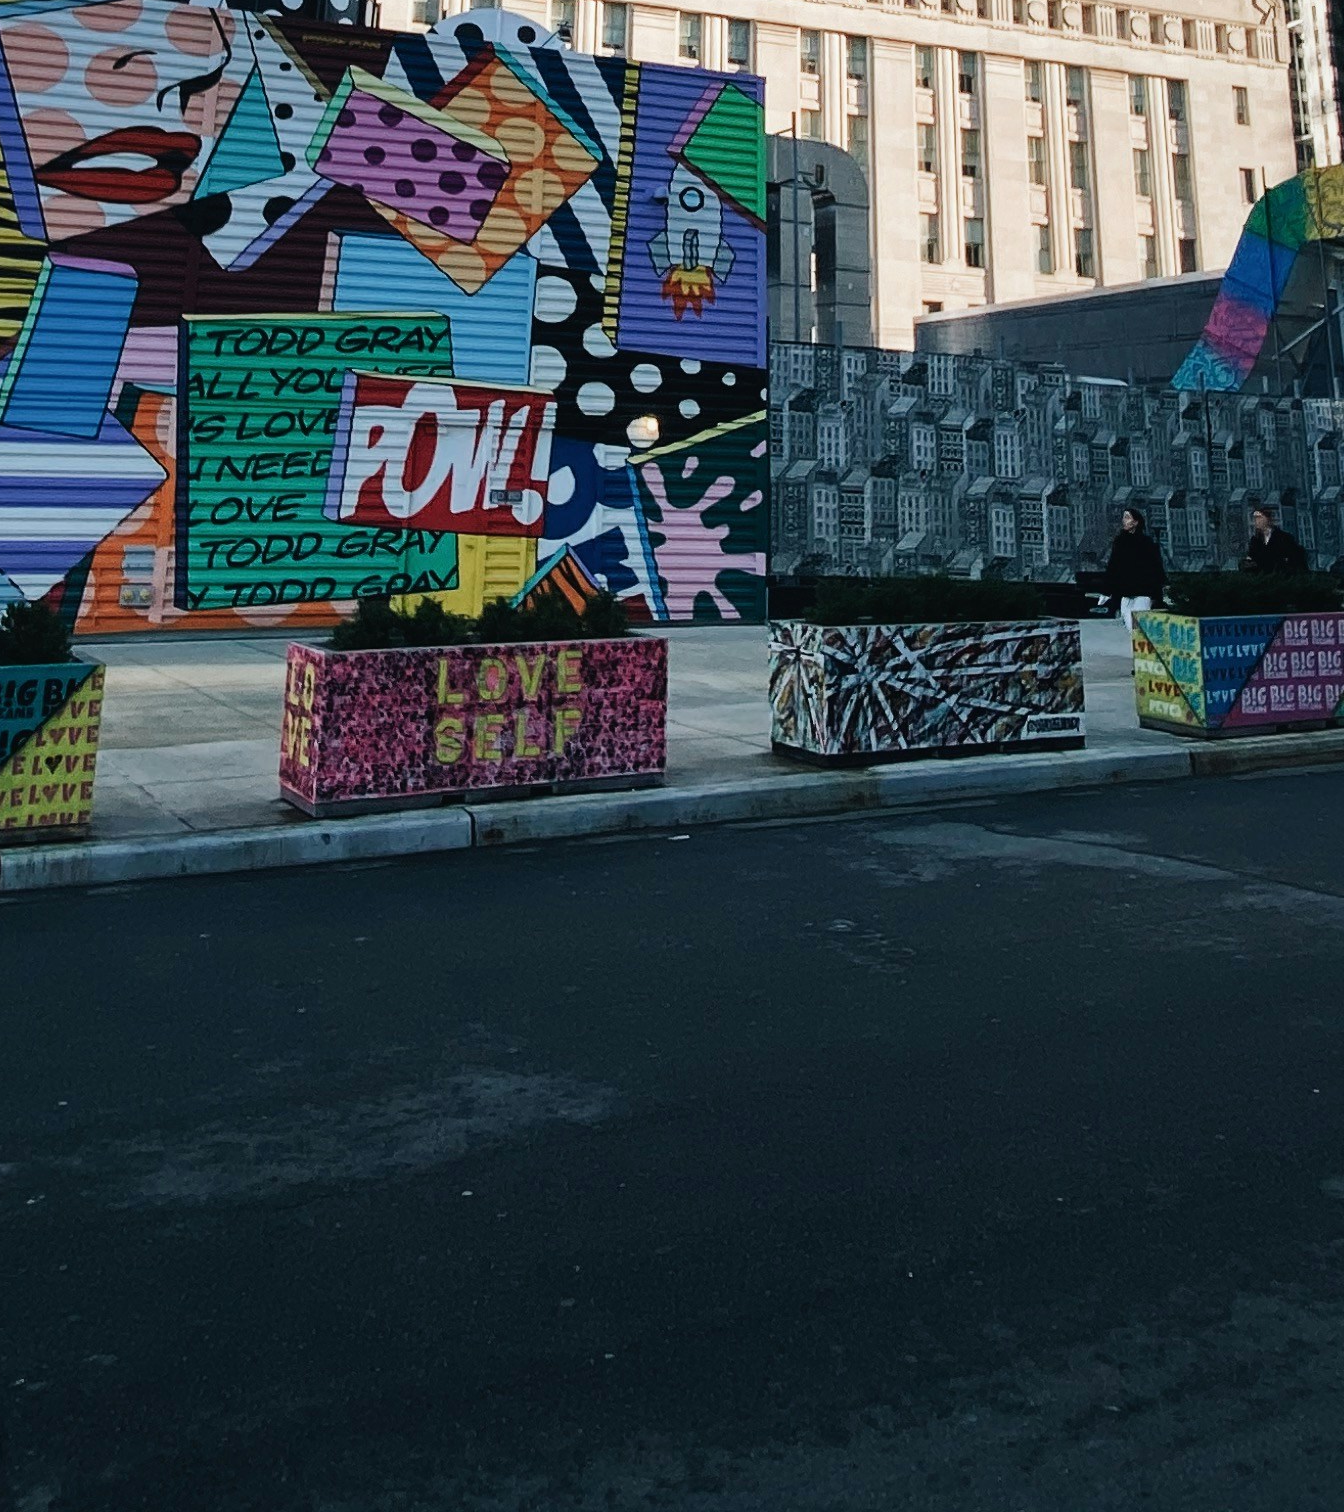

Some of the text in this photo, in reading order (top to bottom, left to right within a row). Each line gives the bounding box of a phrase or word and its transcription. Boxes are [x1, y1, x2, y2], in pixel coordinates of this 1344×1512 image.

[207, 325, 450, 356] TODD GRAY
[188, 371, 260, 400] ALL
[236, 408, 339, 441] LOVE
[201, 528, 447, 568] TODD GRAY
[436, 649, 583, 705] LOVE
[434, 708, 582, 764] SELF
